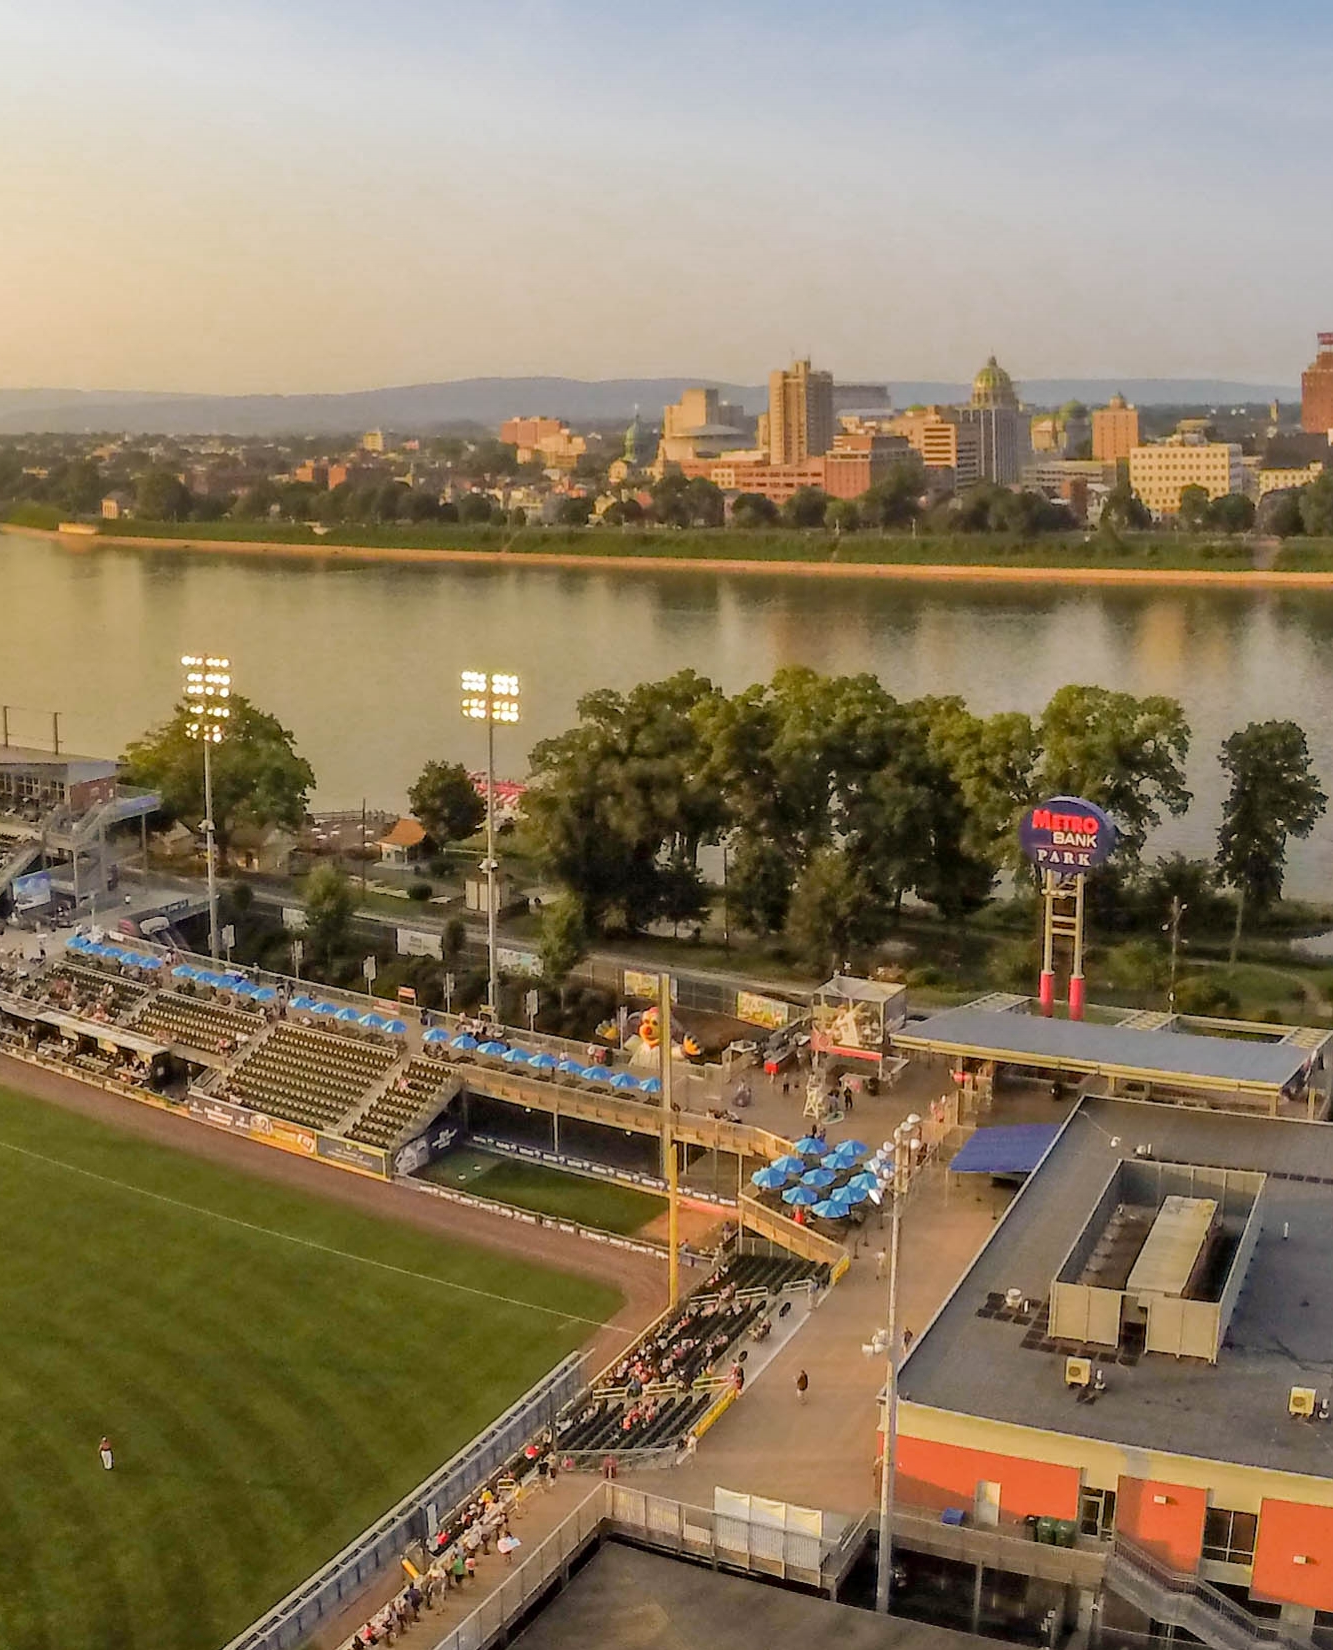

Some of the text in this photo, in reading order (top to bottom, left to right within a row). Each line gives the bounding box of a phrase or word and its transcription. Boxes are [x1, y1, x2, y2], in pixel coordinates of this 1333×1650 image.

[1032, 809, 1099, 834] METRO
[1053, 831, 1097, 848] BANK
[1037, 849, 1091, 867] PARK
